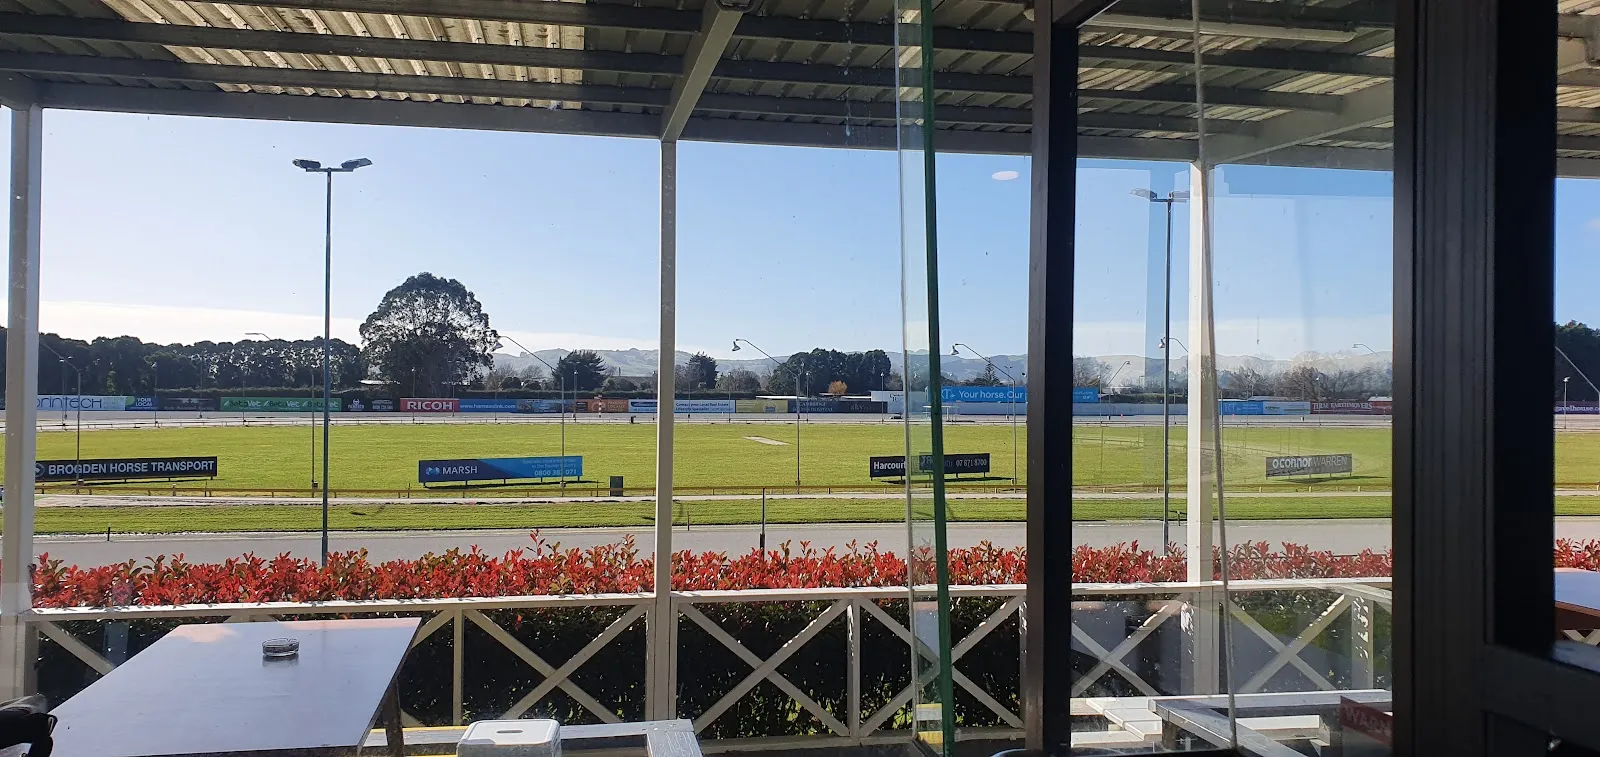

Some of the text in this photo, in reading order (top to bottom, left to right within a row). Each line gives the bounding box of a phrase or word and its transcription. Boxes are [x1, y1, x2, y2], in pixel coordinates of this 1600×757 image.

[959, 391, 979, 399] Your
[980, 390, 1006, 399] horse.
[1007, 391, 1023, 399] Our
[407, 401, 453, 410] RICOH
[49, 460, 215, 475] BROGDEN HORSE TRANSPORT
[442, 466, 478, 475] MARSH
